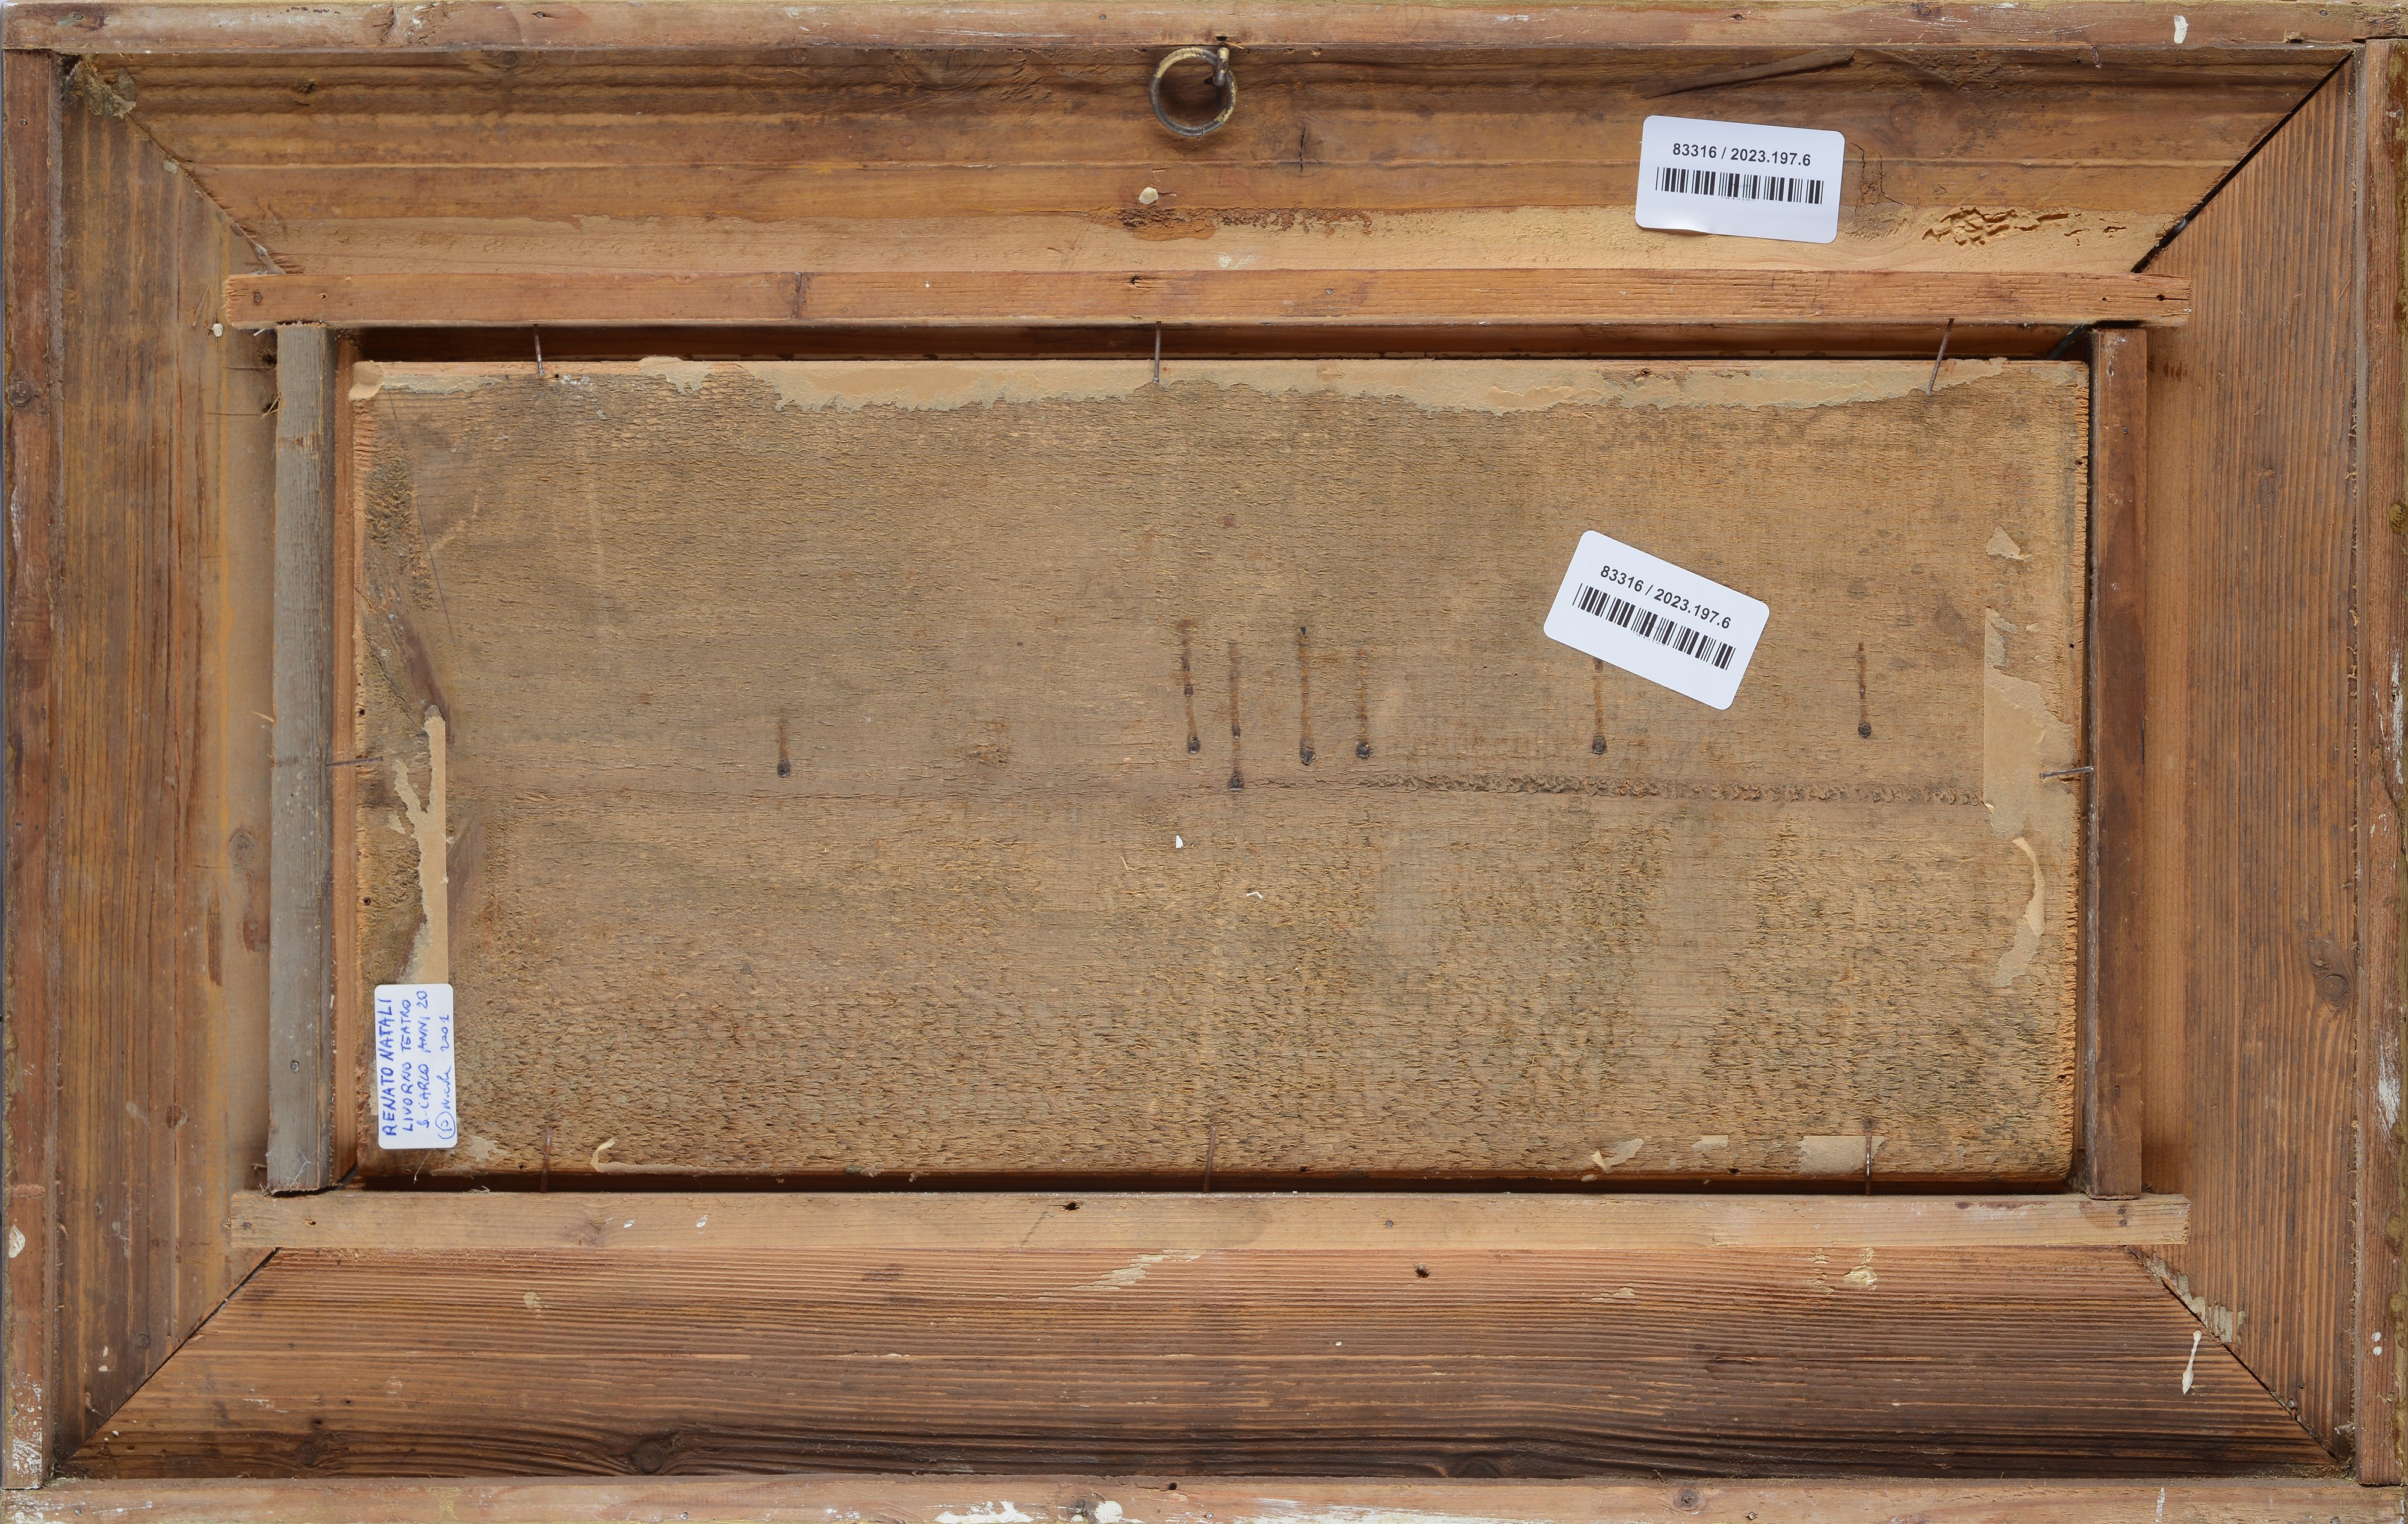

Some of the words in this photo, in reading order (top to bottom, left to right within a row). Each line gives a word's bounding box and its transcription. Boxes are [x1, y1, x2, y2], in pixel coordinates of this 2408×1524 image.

[1672, 143, 1717, 158] 83316
[1721, 146, 1727, 160] /
[1730, 147, 1811, 167] 2023.197.6
[1600, 565, 1644, 592] 83316
[1645, 584, 1654, 596] /
[1654, 588, 1731, 629] 2023.197.6
[416, 991, 428, 1009] 20
[377, 998, 395, 1061] NATALI
[400, 999, 411, 1052] TEATRO
[417, 1016, 432, 1053] ANNI
[439, 1014, 450, 1052] 2001
[380, 1067, 397, 1136] RENATO
[400, 1062, 414, 1131] LIVORNO
[417, 1064, 431, 1109] CARLO
